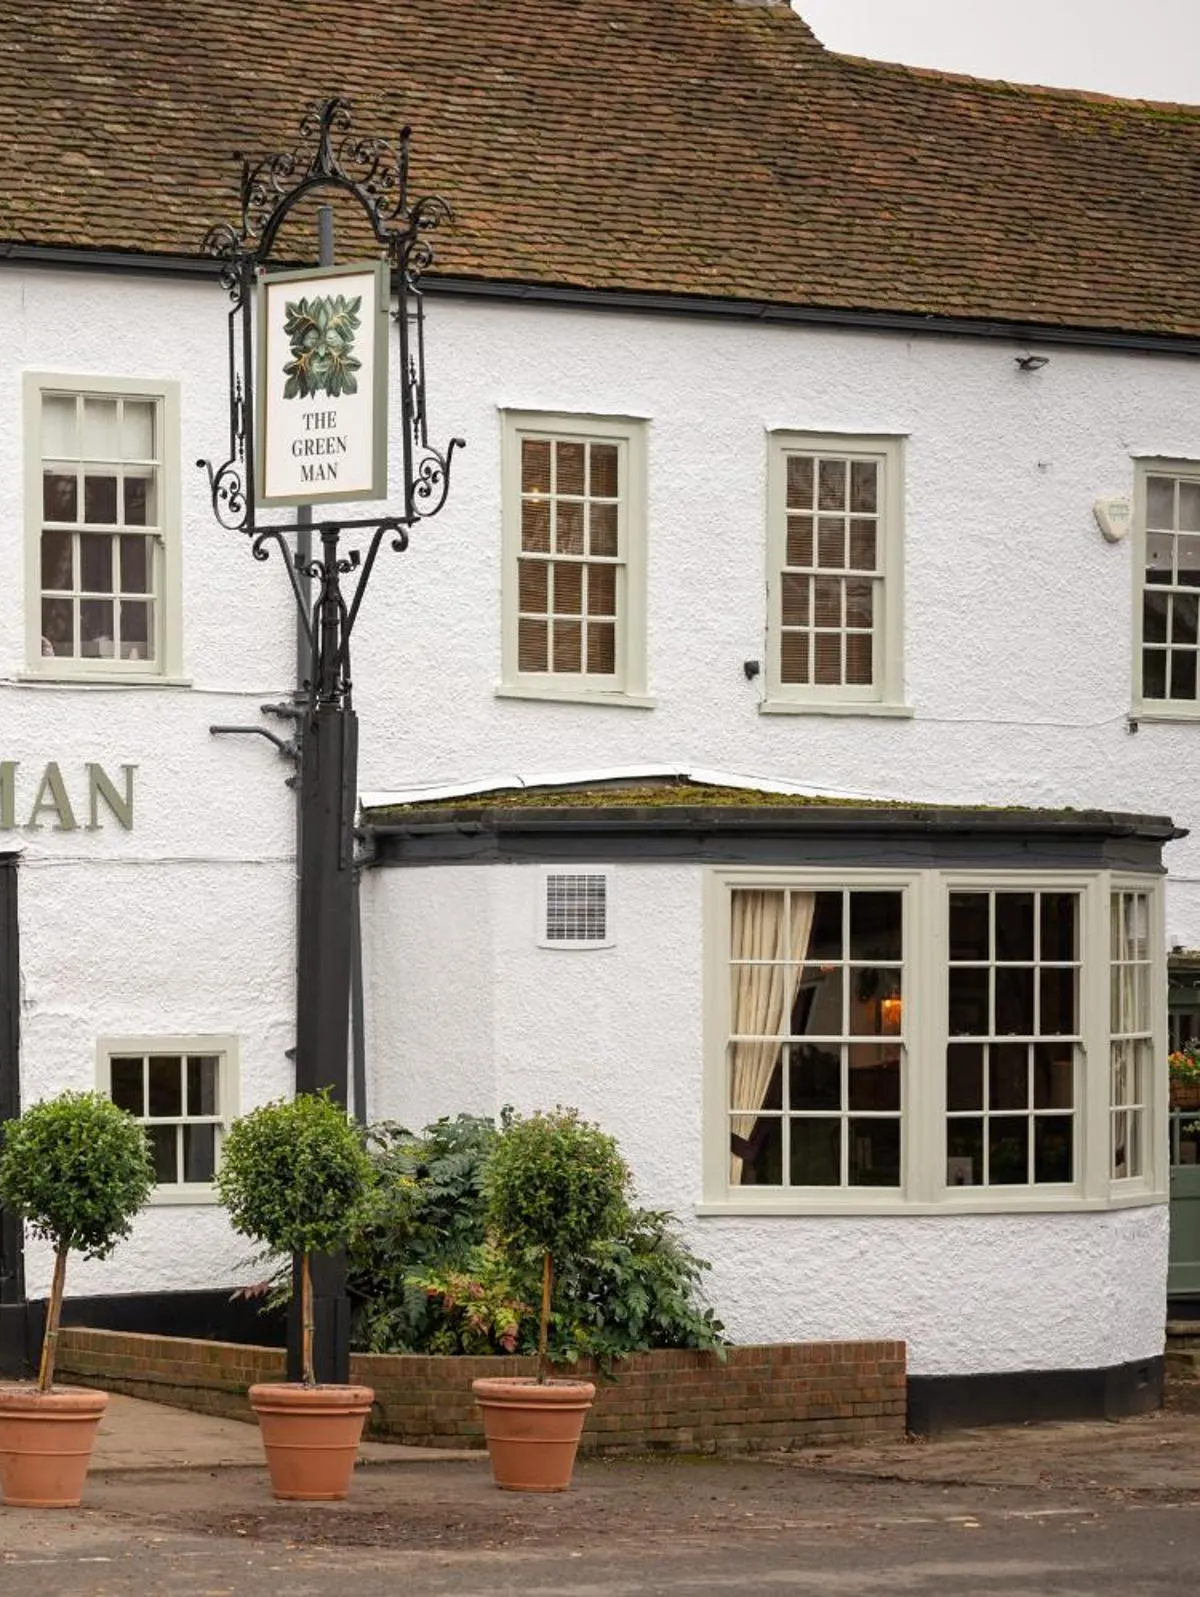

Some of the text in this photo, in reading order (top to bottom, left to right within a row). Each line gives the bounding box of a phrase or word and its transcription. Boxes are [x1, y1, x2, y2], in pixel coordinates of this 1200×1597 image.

[302, 411, 337, 431] THE
[291, 435, 348, 457] GREEN
[300, 462, 338, 482] MAN
